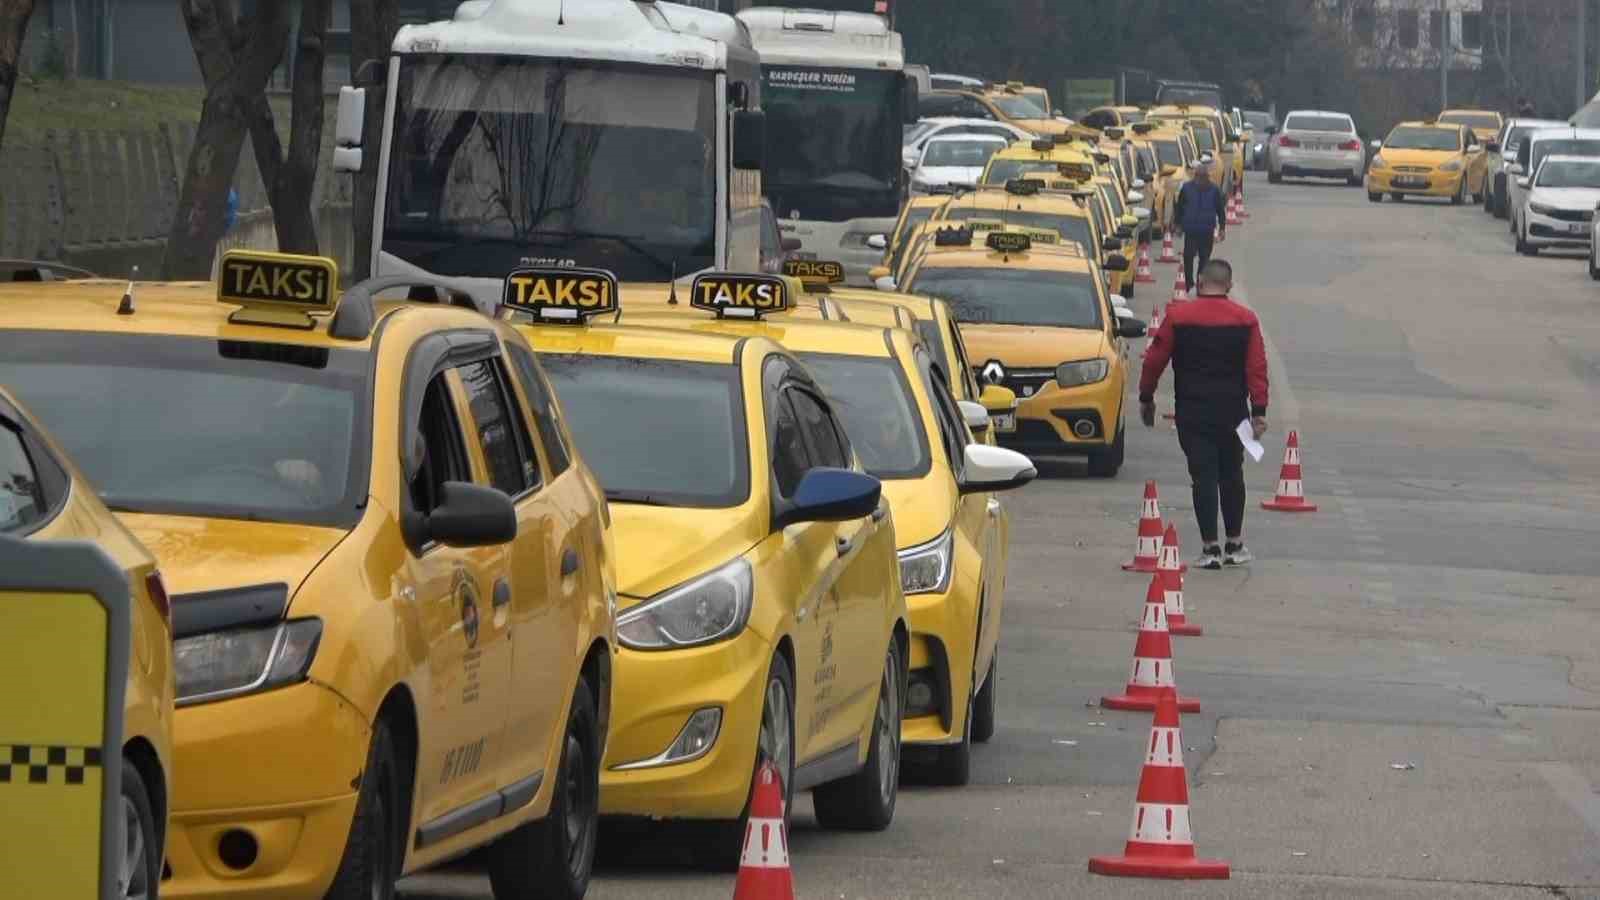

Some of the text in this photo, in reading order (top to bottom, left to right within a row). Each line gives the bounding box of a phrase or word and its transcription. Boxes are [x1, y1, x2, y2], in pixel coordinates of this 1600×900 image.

[227, 264, 326, 302] TAKSi
[511, 277, 609, 307] TAKSi
[698, 281, 782, 307] TAKSi
